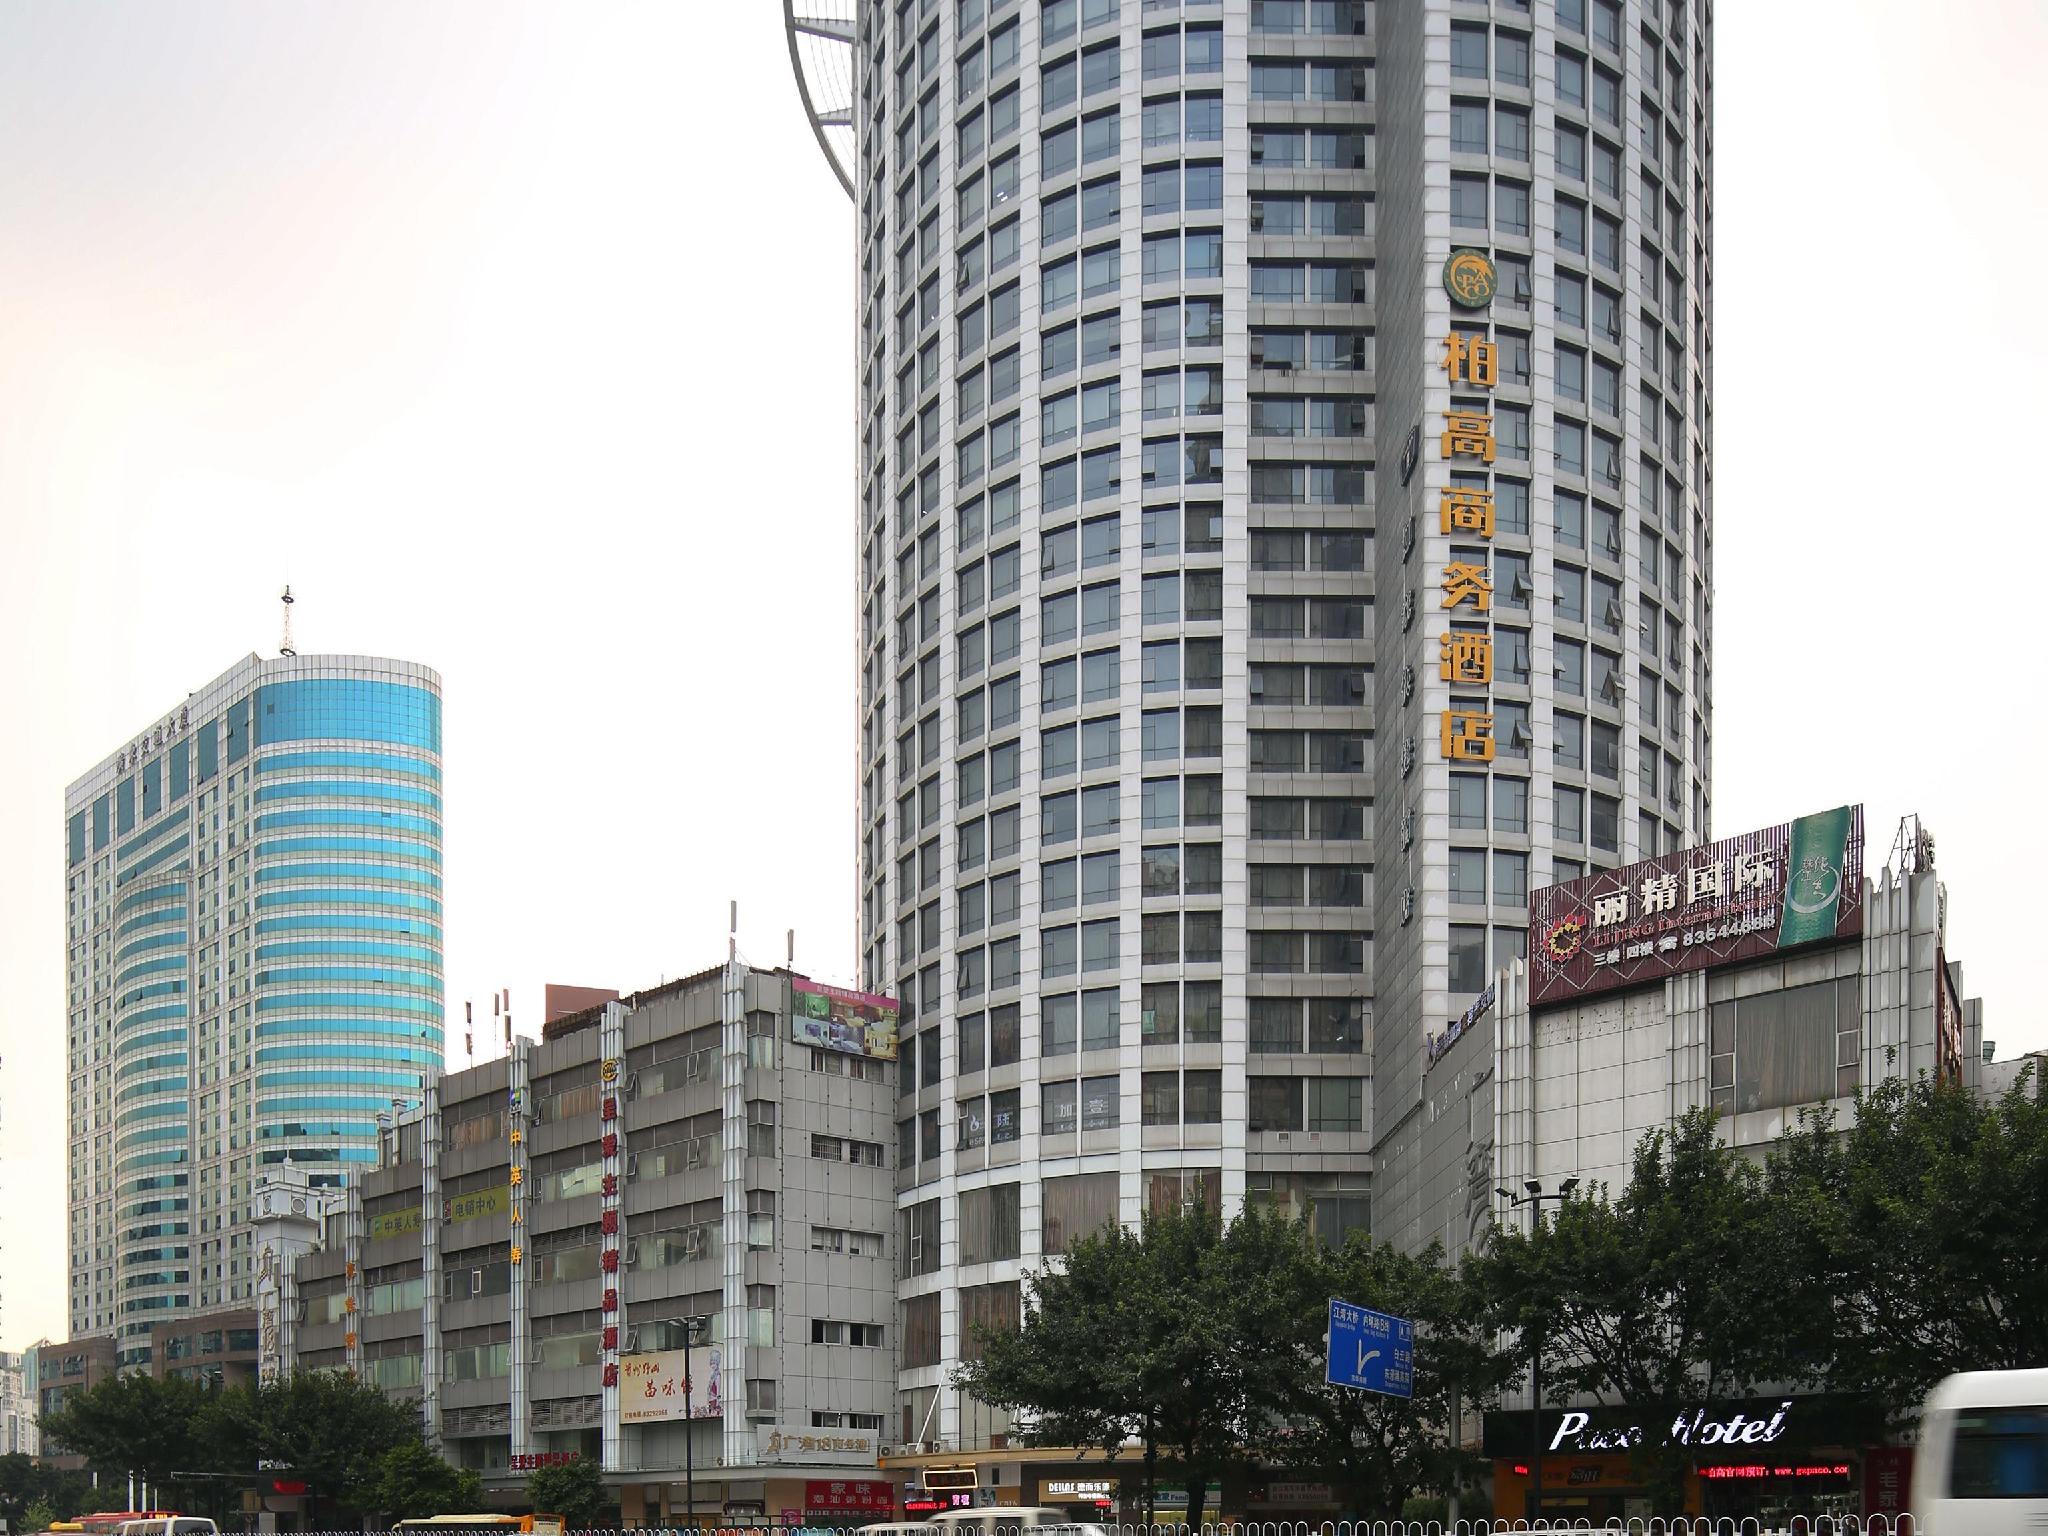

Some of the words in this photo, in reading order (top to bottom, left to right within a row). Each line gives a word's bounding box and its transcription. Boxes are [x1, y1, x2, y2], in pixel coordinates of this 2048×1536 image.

[1441, 331, 1498, 764] 柏高商务酒店
[1593, 851, 1776, 929] 丽精国际
[455, 1196, 496, 1217] 电销中心
[510, 1128, 523, 1266] 中英人寿
[1664, 1401, 1792, 1447] Hotel
[831, 1483, 871, 1495] 家味
